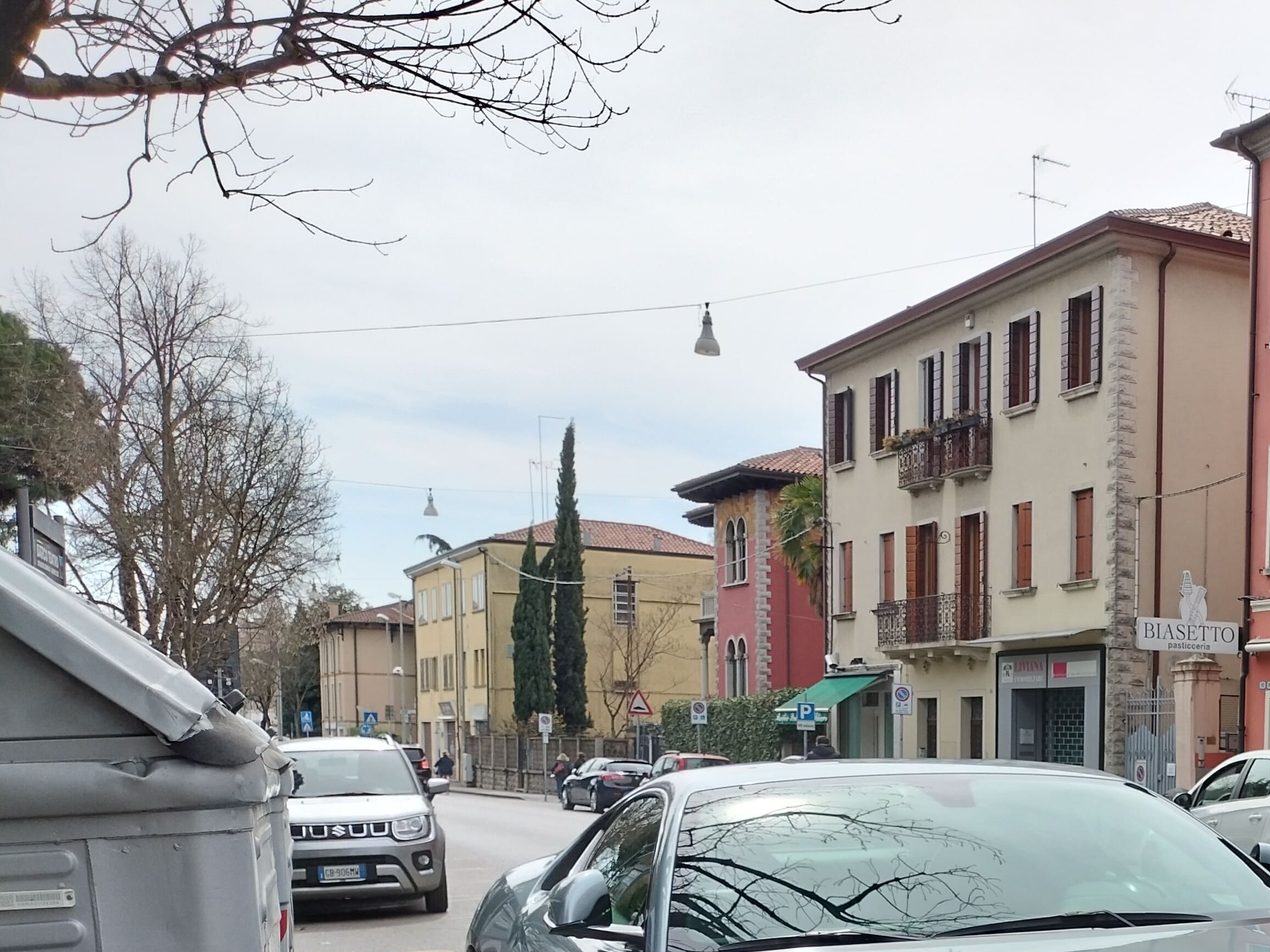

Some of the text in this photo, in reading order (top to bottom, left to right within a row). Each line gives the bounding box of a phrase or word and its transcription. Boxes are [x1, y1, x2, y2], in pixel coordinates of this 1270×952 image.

[1143, 622, 1235, 644] BIASETTO
[1167, 641, 1211, 651] pasticceria
[800, 704, 812, 719] P
